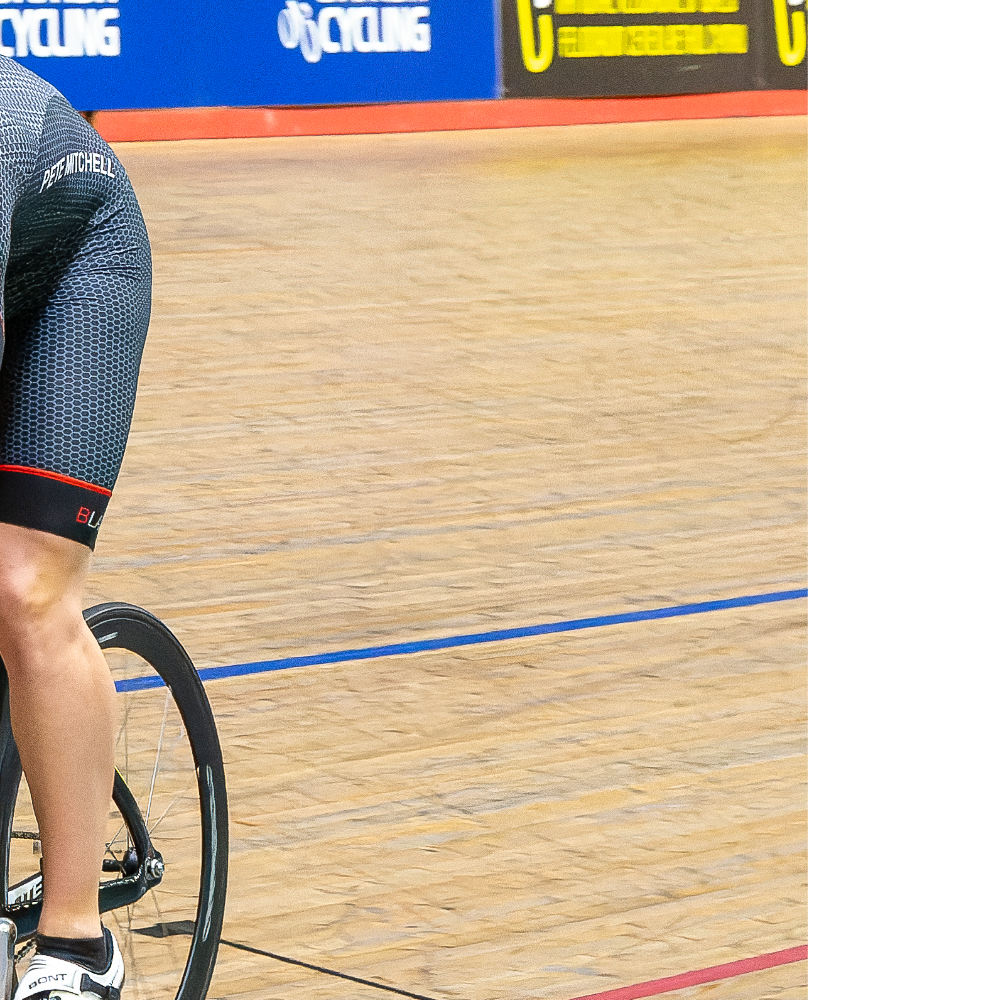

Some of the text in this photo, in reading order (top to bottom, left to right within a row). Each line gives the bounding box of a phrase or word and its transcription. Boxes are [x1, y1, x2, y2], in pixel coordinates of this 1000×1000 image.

[318, 6, 432, 53] CYCLING
[39, 152, 116, 194] PETE MITCHELL
[28, 973, 68, 990] BONT
